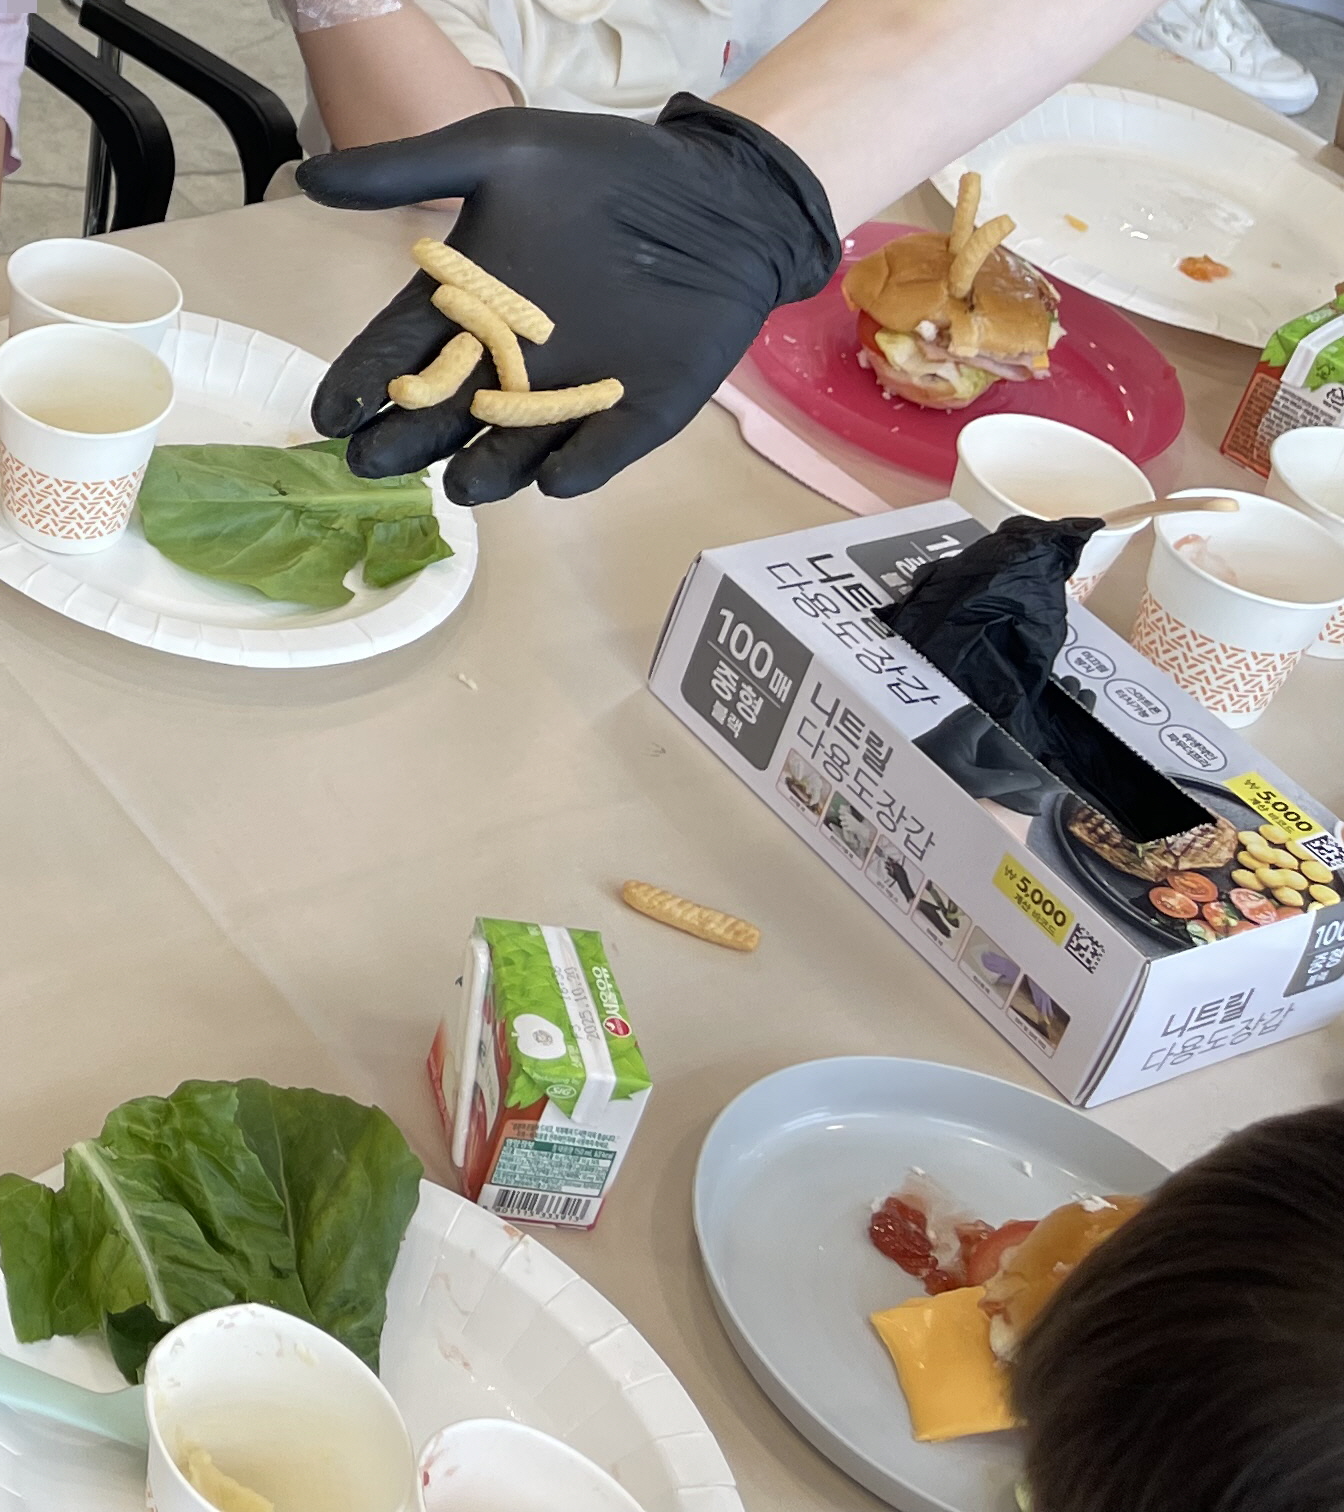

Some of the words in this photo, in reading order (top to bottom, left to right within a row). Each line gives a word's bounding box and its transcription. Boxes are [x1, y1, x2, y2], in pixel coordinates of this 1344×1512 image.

[766, 562, 941, 706] 다용도장갑
[711, 660, 764, 725] 중형
[1124, 686, 1162, 715] 스마트폰
[810, 681, 894, 778] 니트릴
[796, 715, 936, 861] 다용도장갑
[1256, 790, 1313, 832] 5,000
[1016, 876, 1066, 927] 5,000
[564, 966, 600, 1041] 2025.10.20
[1140, 1002, 1296, 1072] 다용도장갑
[1160, 987, 1255, 1038] 니트릴
